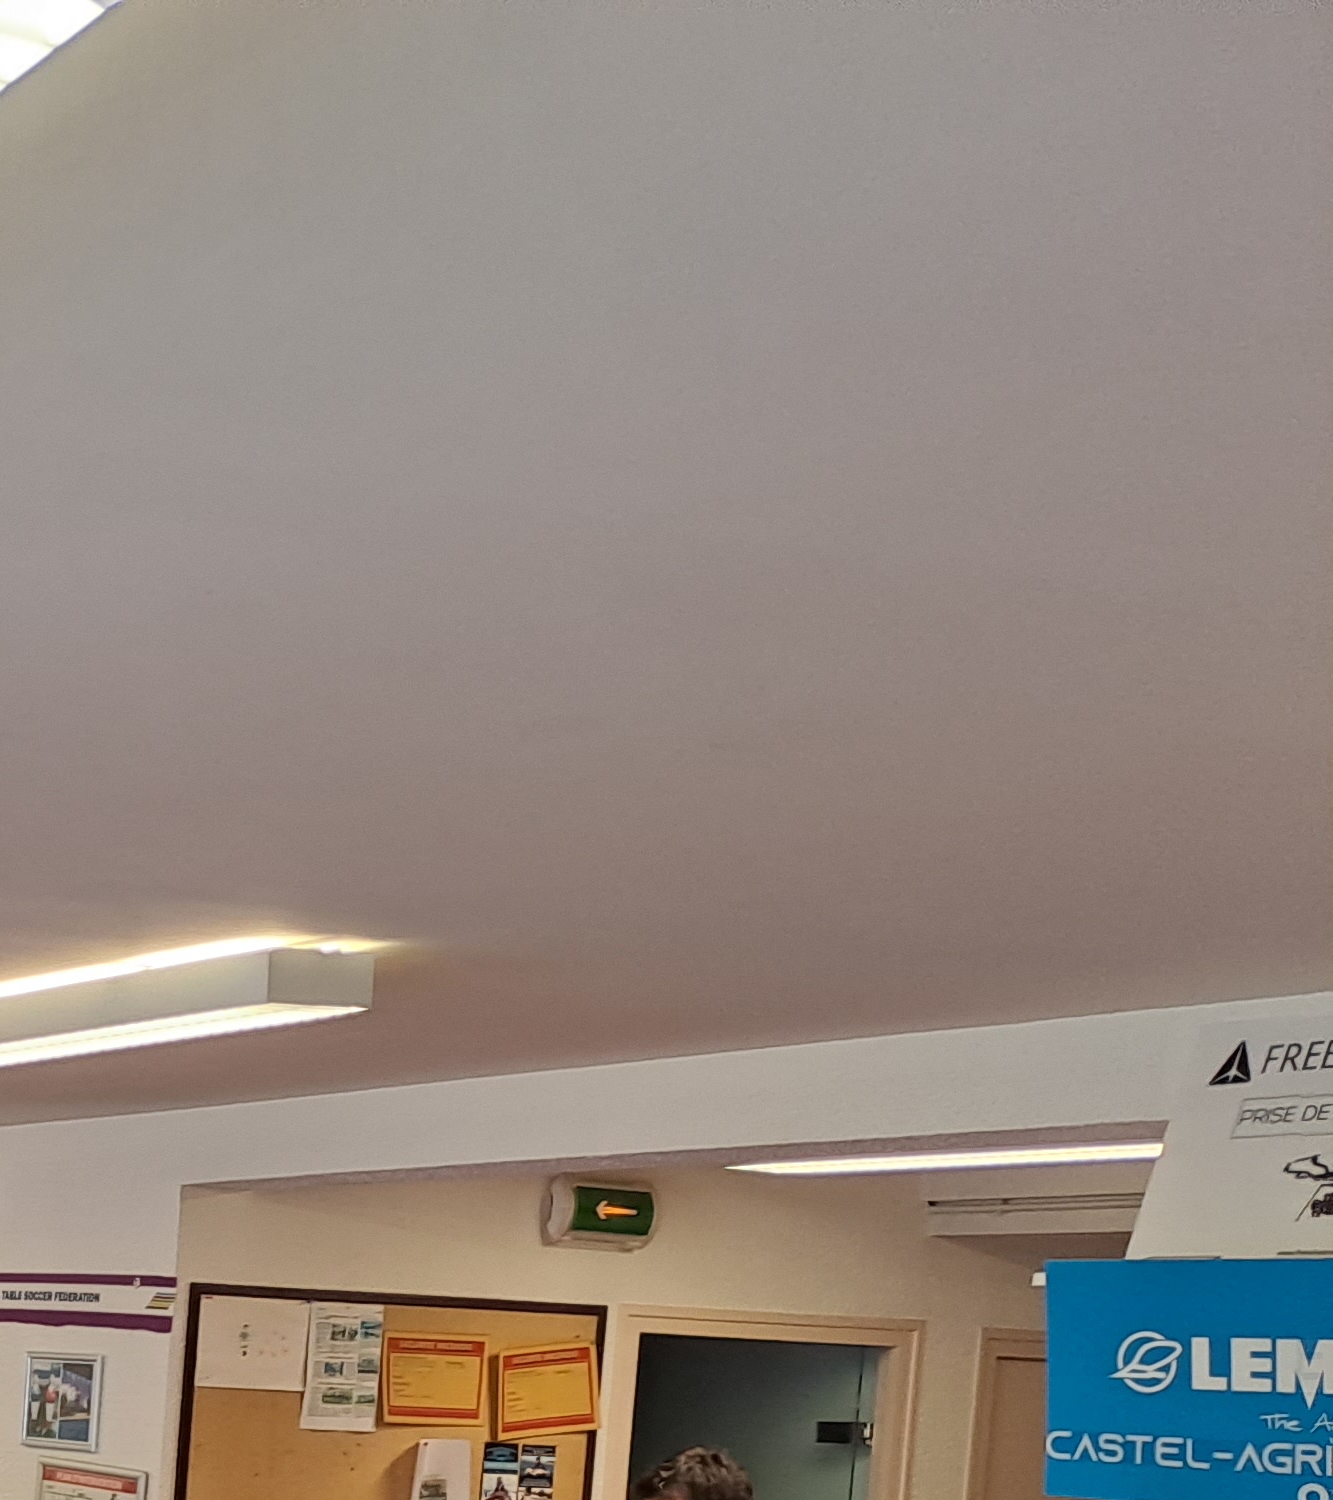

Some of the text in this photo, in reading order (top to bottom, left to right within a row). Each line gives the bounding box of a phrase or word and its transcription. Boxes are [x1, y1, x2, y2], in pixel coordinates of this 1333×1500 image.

[1240, 1103, 1333, 1124] PRISE DE
[1310, 1412, 1333, 1433] A
